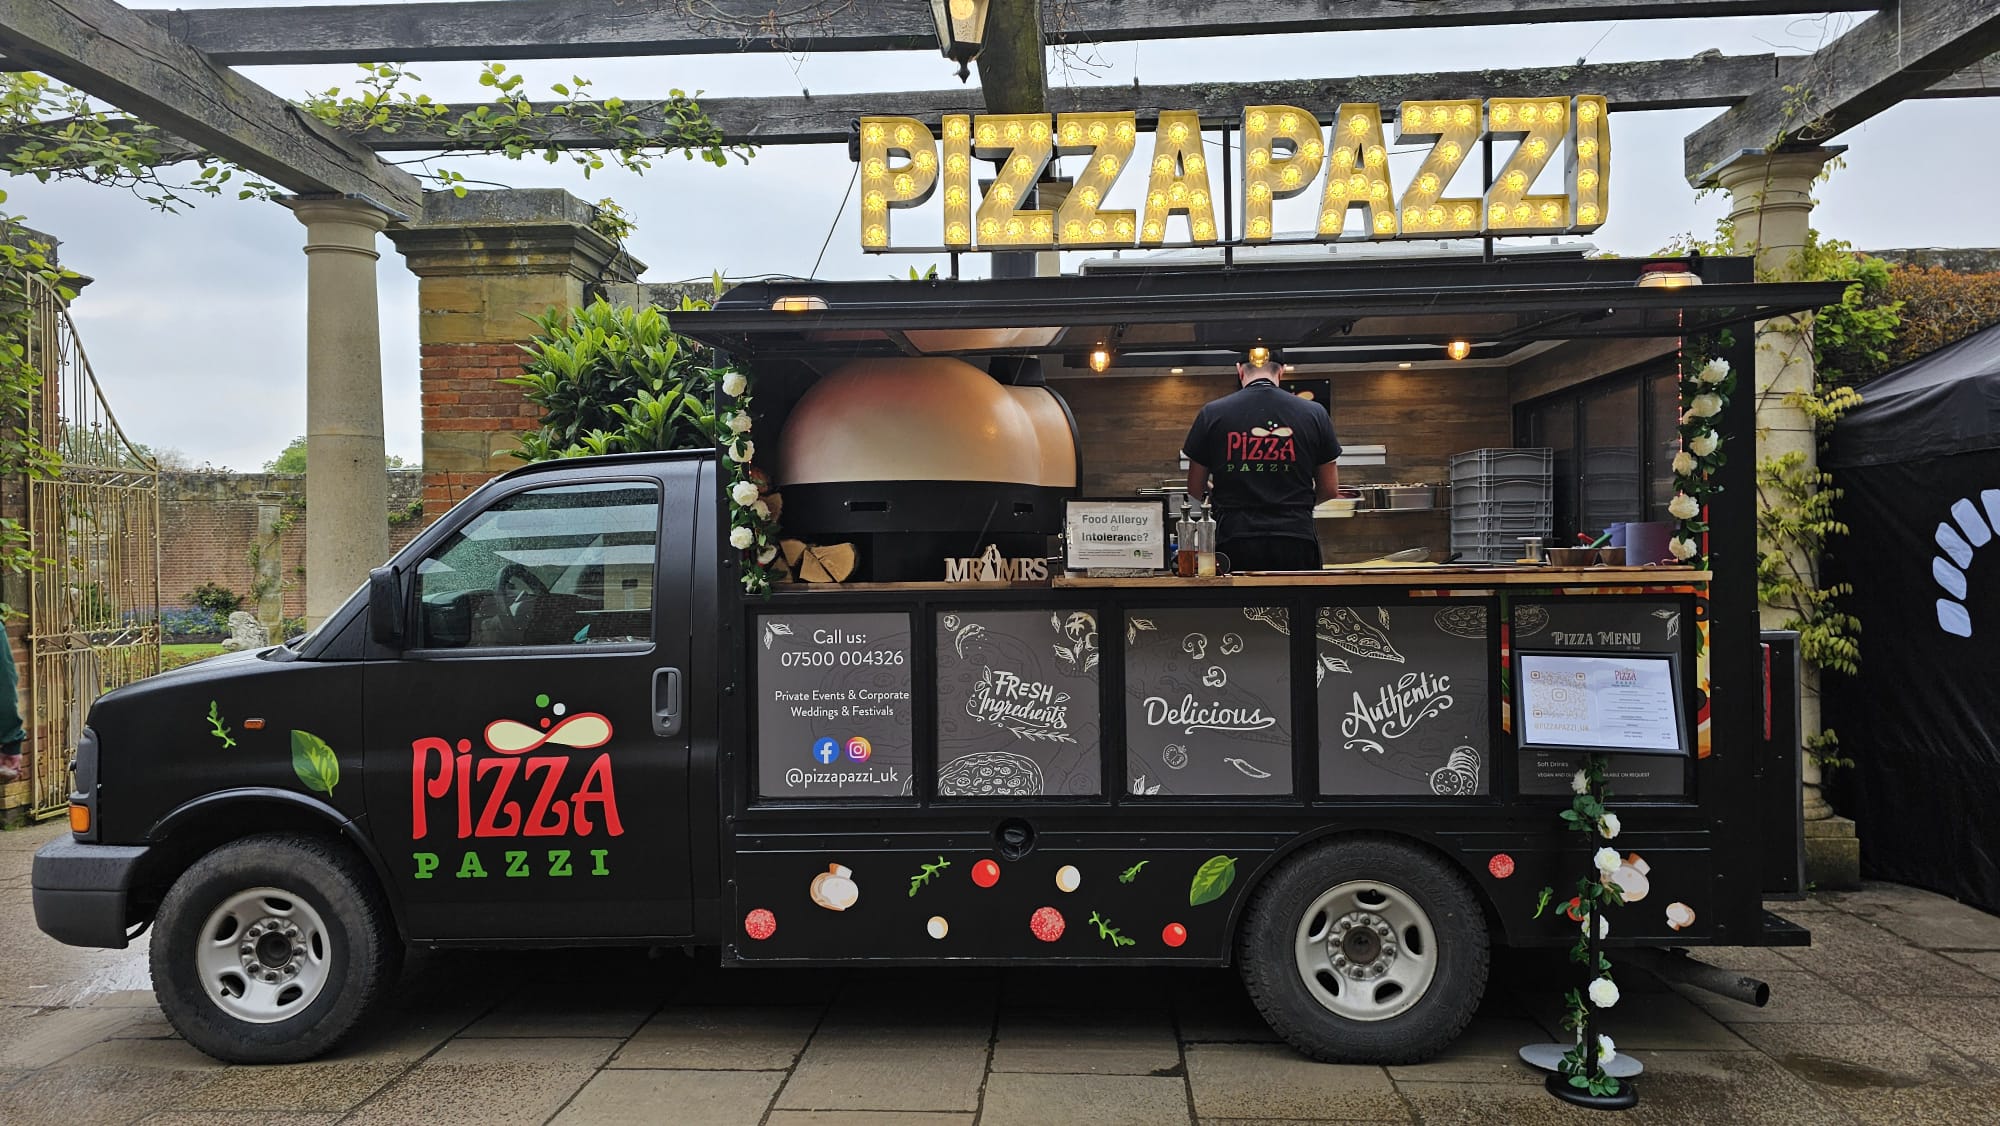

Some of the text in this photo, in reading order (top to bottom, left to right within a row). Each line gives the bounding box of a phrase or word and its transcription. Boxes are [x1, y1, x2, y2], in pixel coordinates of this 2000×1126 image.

[860, 95, 1608, 253] PIZZA PAZZI
[1227, 463, 1291, 472] PAZZI
[1082, 514, 1148, 525] Food Allergy
[1081, 532, 1149, 542] Intolerance?
[943, 557, 1048, 582] MR MRS
[813, 629, 867, 644] Call us:
[1551, 631, 1641, 646] PIZZA MENU
[781, 650, 904, 666] 07500 004326
[775, 689, 910, 703] Private Events & Corporate
[791, 705, 894, 719] Weddings & Festivals
[978, 687, 1068, 729] Ingredients
[1143, 693, 1276, 733] Delicious
[1341, 672, 1454, 739] Authentic
[785, 767, 898, 788] @pizzapazzi_uk
[412, 849, 610, 879] PAZZI
